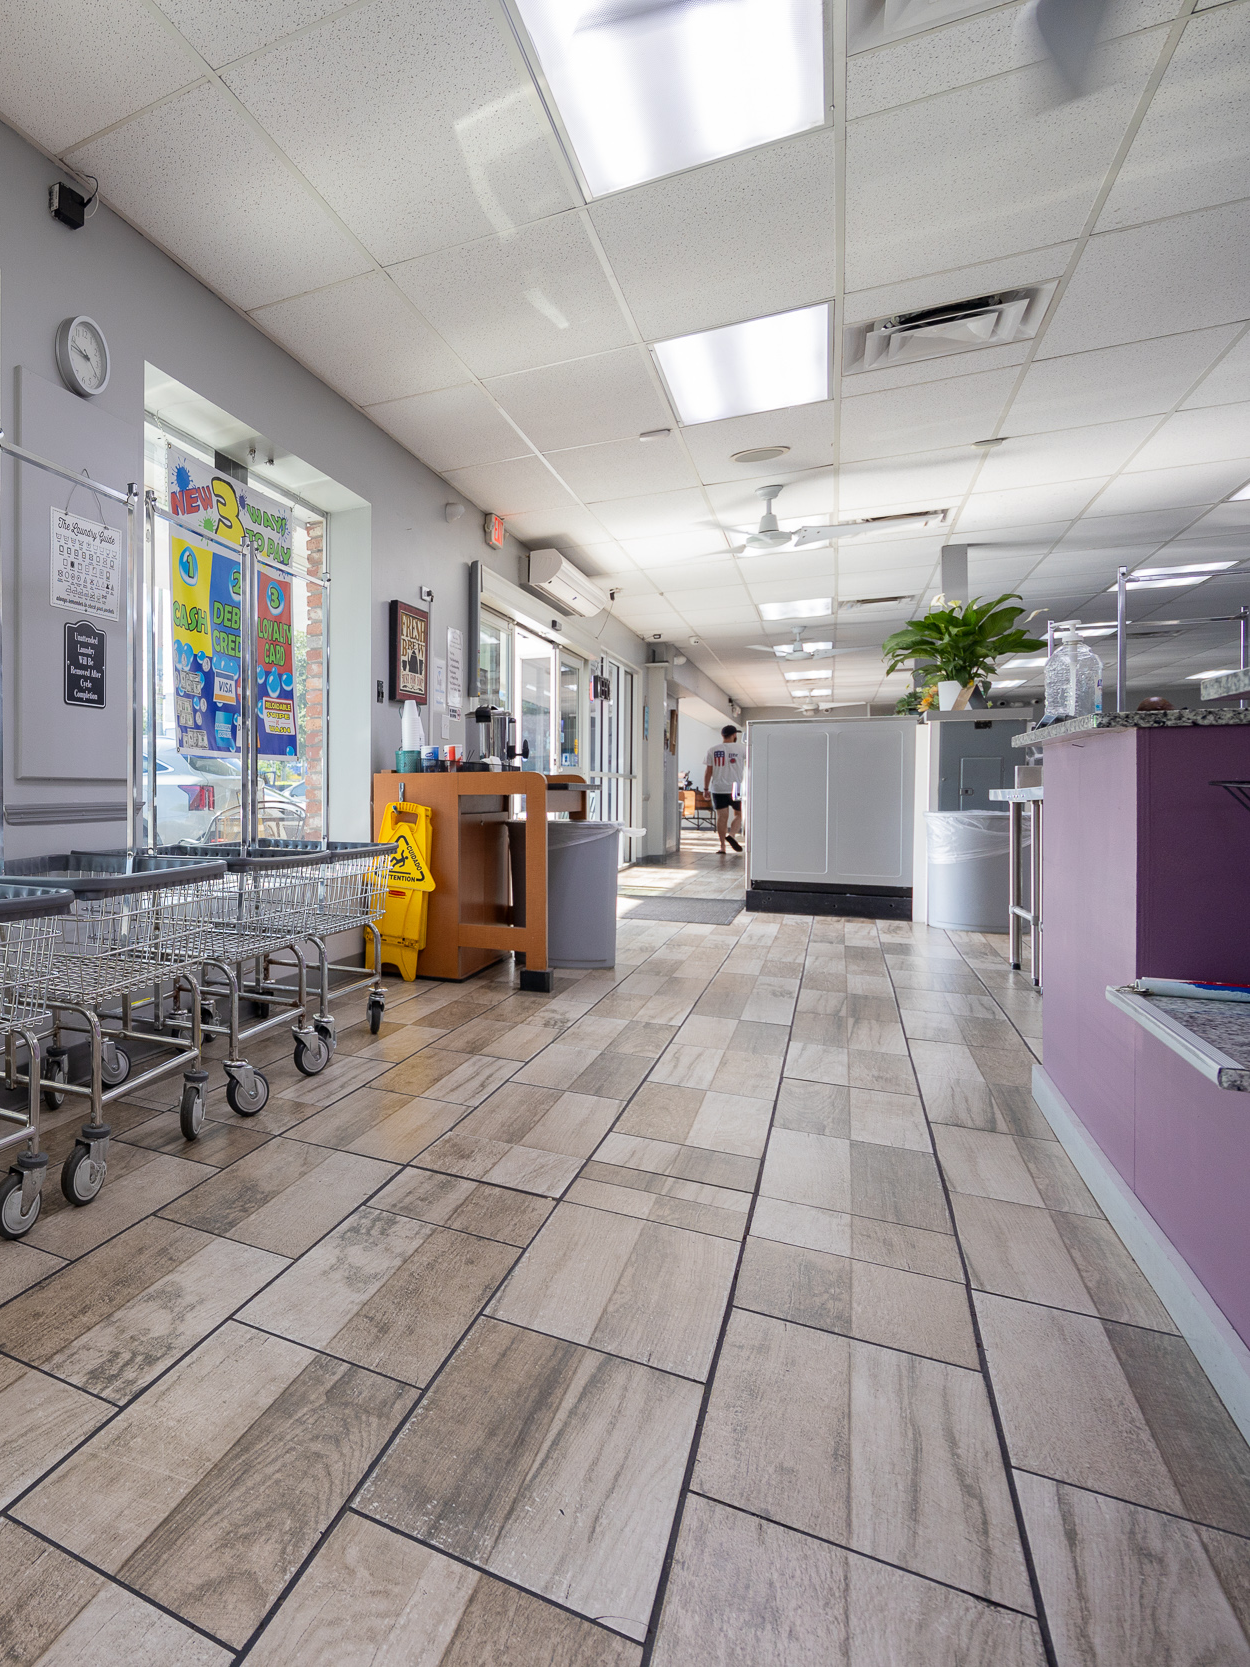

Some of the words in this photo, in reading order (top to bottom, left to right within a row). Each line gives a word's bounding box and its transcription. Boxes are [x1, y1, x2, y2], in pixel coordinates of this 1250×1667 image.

[170, 484, 213, 516] NEW
[210, 476, 245, 546] 3
[246, 503, 287, 537] WAYS
[58, 516, 70, 531] The
[71, 522, 97, 543] Laundry
[98, 530, 115, 546] Guide
[245, 527, 265, 553] TO
[266, 537, 291, 566] PAY
[186, 553, 194, 579] 1
[232, 571, 241, 596] 2
[269, 586, 280, 609] 3
[172, 600, 209, 635] CASH
[401, 612, 426, 643] FRESH
[74, 631, 99, 645] Unattended
[257, 616, 292, 645] LOYALTY
[77, 643, 95, 657] Laundry
[264, 642, 286, 667] CARD
[402, 638, 426, 658] BREW
[70, 665, 91, 677] Removed
[91, 669, 102, 679] After
[78, 655, 87, 665] Will
[87, 657, 94, 666] Be
[73, 688, 98, 701] Completion
[80, 678, 92, 689] Cycle
[218, 680, 233, 694] VISA
[265, 701, 291, 711] RELOADABLE
[266, 711, 290, 720] SWIPE
[269, 724, 292, 733] WASH
[406, 845, 423, 872] CUIDADO
